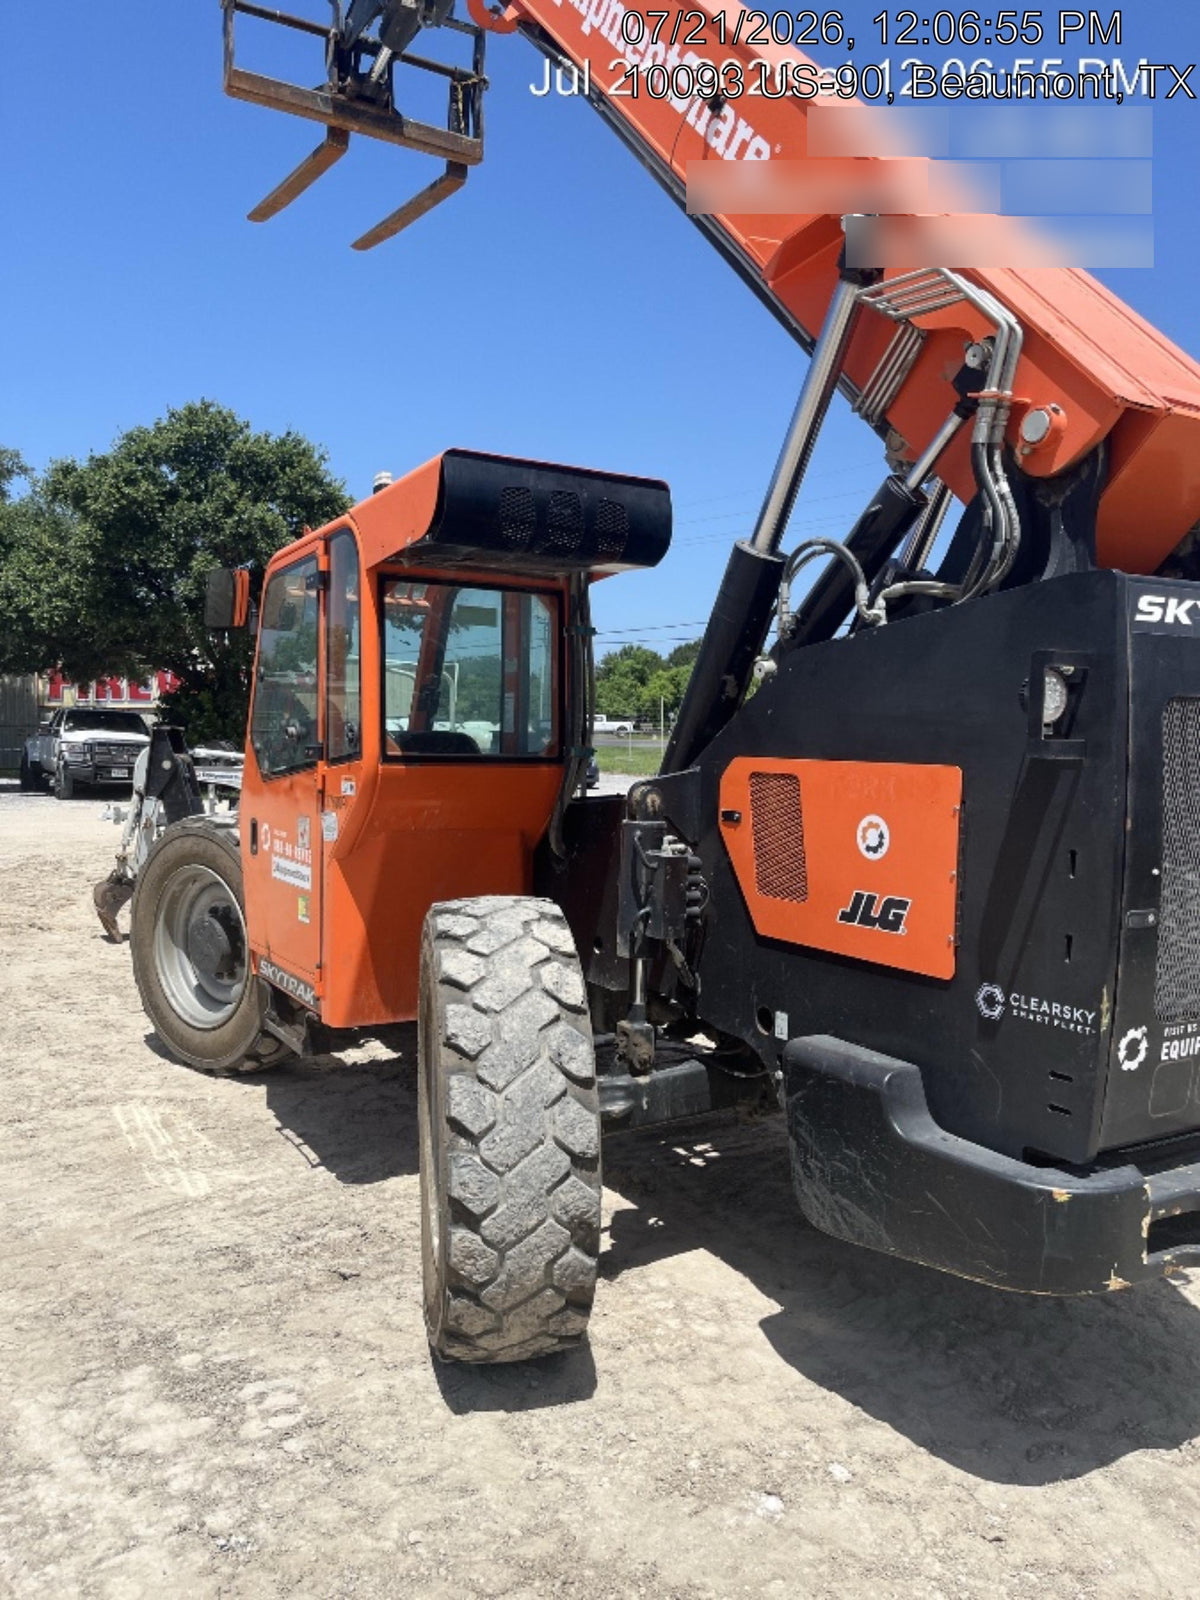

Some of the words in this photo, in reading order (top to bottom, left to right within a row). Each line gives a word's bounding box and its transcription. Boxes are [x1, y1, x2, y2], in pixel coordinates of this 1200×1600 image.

[1134, 594, 1200, 625] SK
[837, 890, 912, 936] JLG
[259, 959, 316, 1006] SKYTRAK
[1009, 993, 1096, 1025] CLEARSKY
